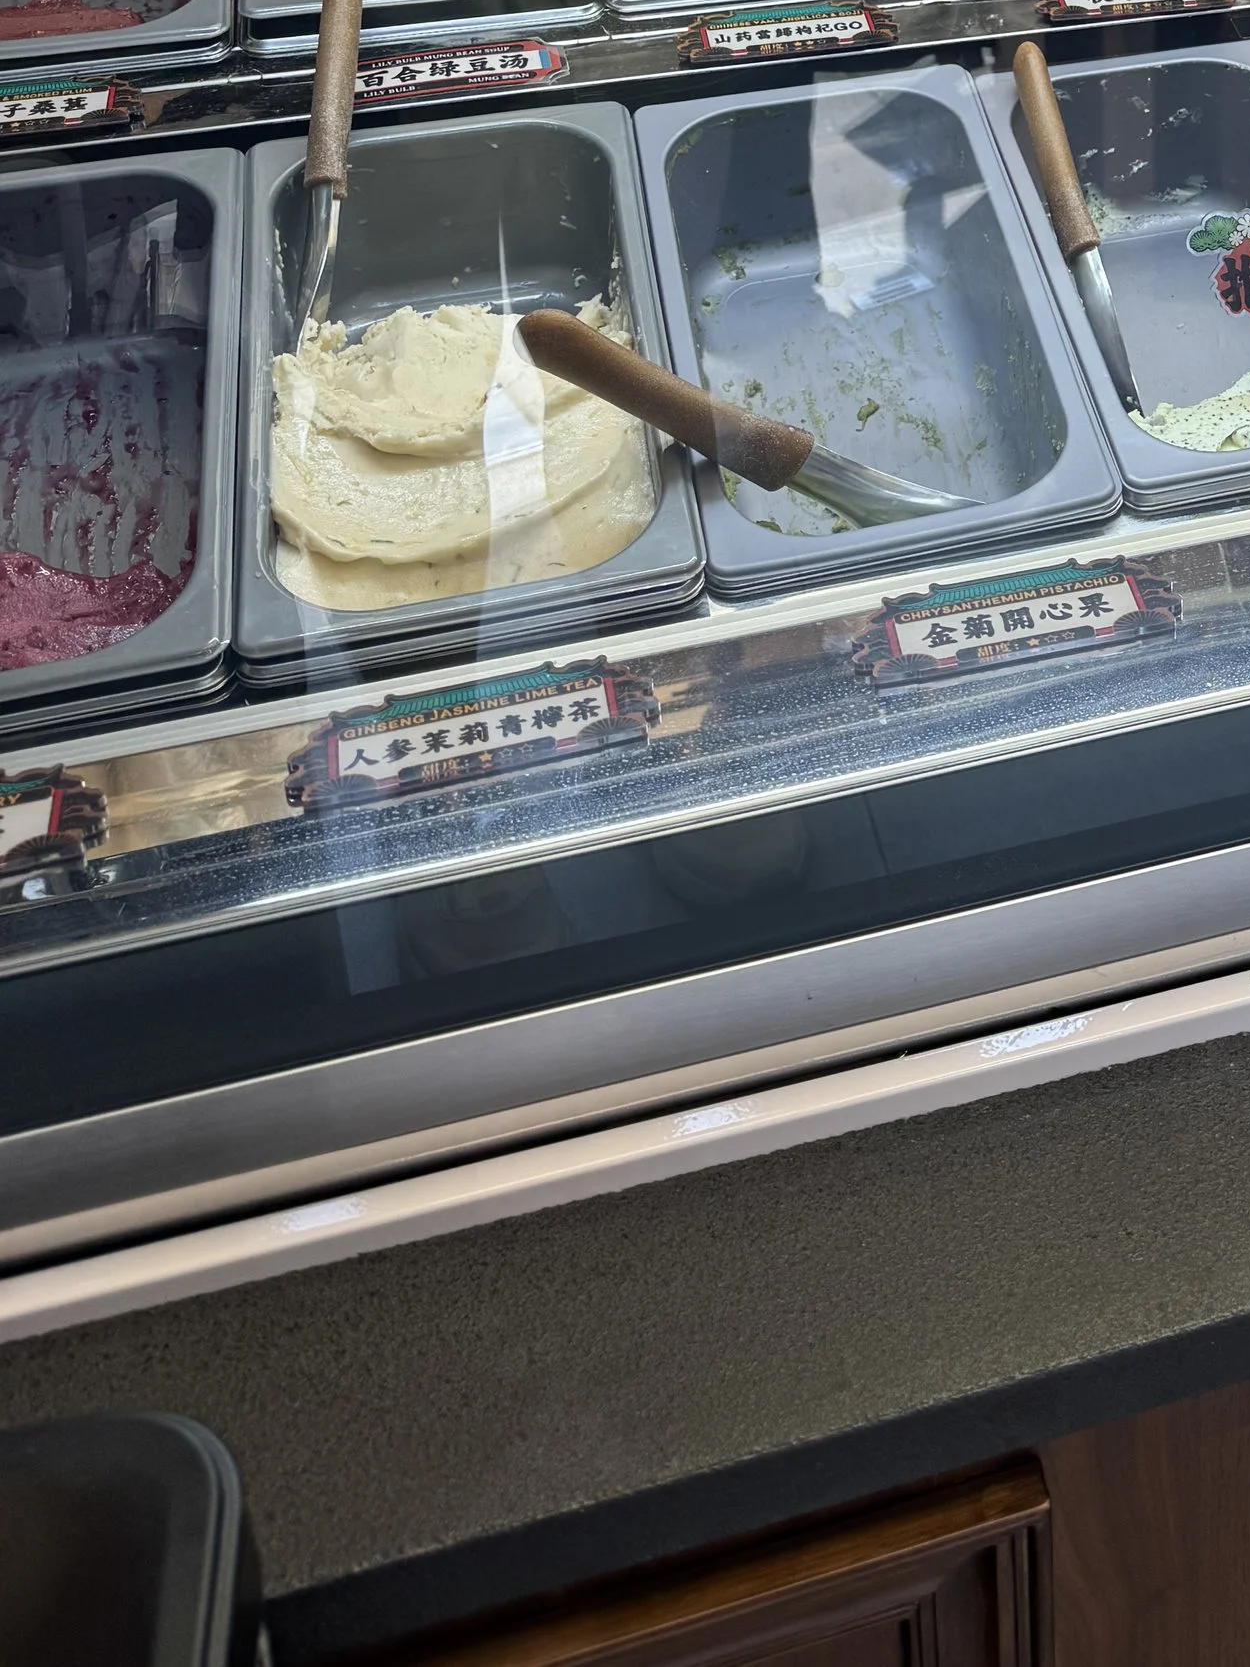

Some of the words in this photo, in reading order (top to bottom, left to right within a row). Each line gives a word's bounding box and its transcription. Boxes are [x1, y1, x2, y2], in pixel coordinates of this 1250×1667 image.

[709, 20, 751, 30] CHINESE
[780, 12, 829, 23] ANGELICA
[372, 60, 394, 68] LILY
[395, 56, 422, 65] BULB
[423, 52, 455, 61] MUNG
[456, 48, 482, 57] BEAN
[484, 45, 510, 54] SOUP
[356, 53, 529, 88] 百合绿豆汤
[468, 75, 500, 83] MUNG
[502, 72, 530, 80] BEAN
[13, 91, 60, 101] SMOKED
[62, 87, 93, 95] PLUM
[363, 89, 385, 98] LILY
[388, 85, 416, 94] BULB
[900, 590, 1037, 622] CHRYSANTHEMUM
[1040, 575, 1119, 596] PISTACHIO
[922, 592, 1115, 649] 金菊開心果
[343, 714, 426, 740] GINSENG
[430, 696, 511, 722] JASMINE
[514, 685, 558, 704] LIME
[562, 677, 599, 694] TEA
